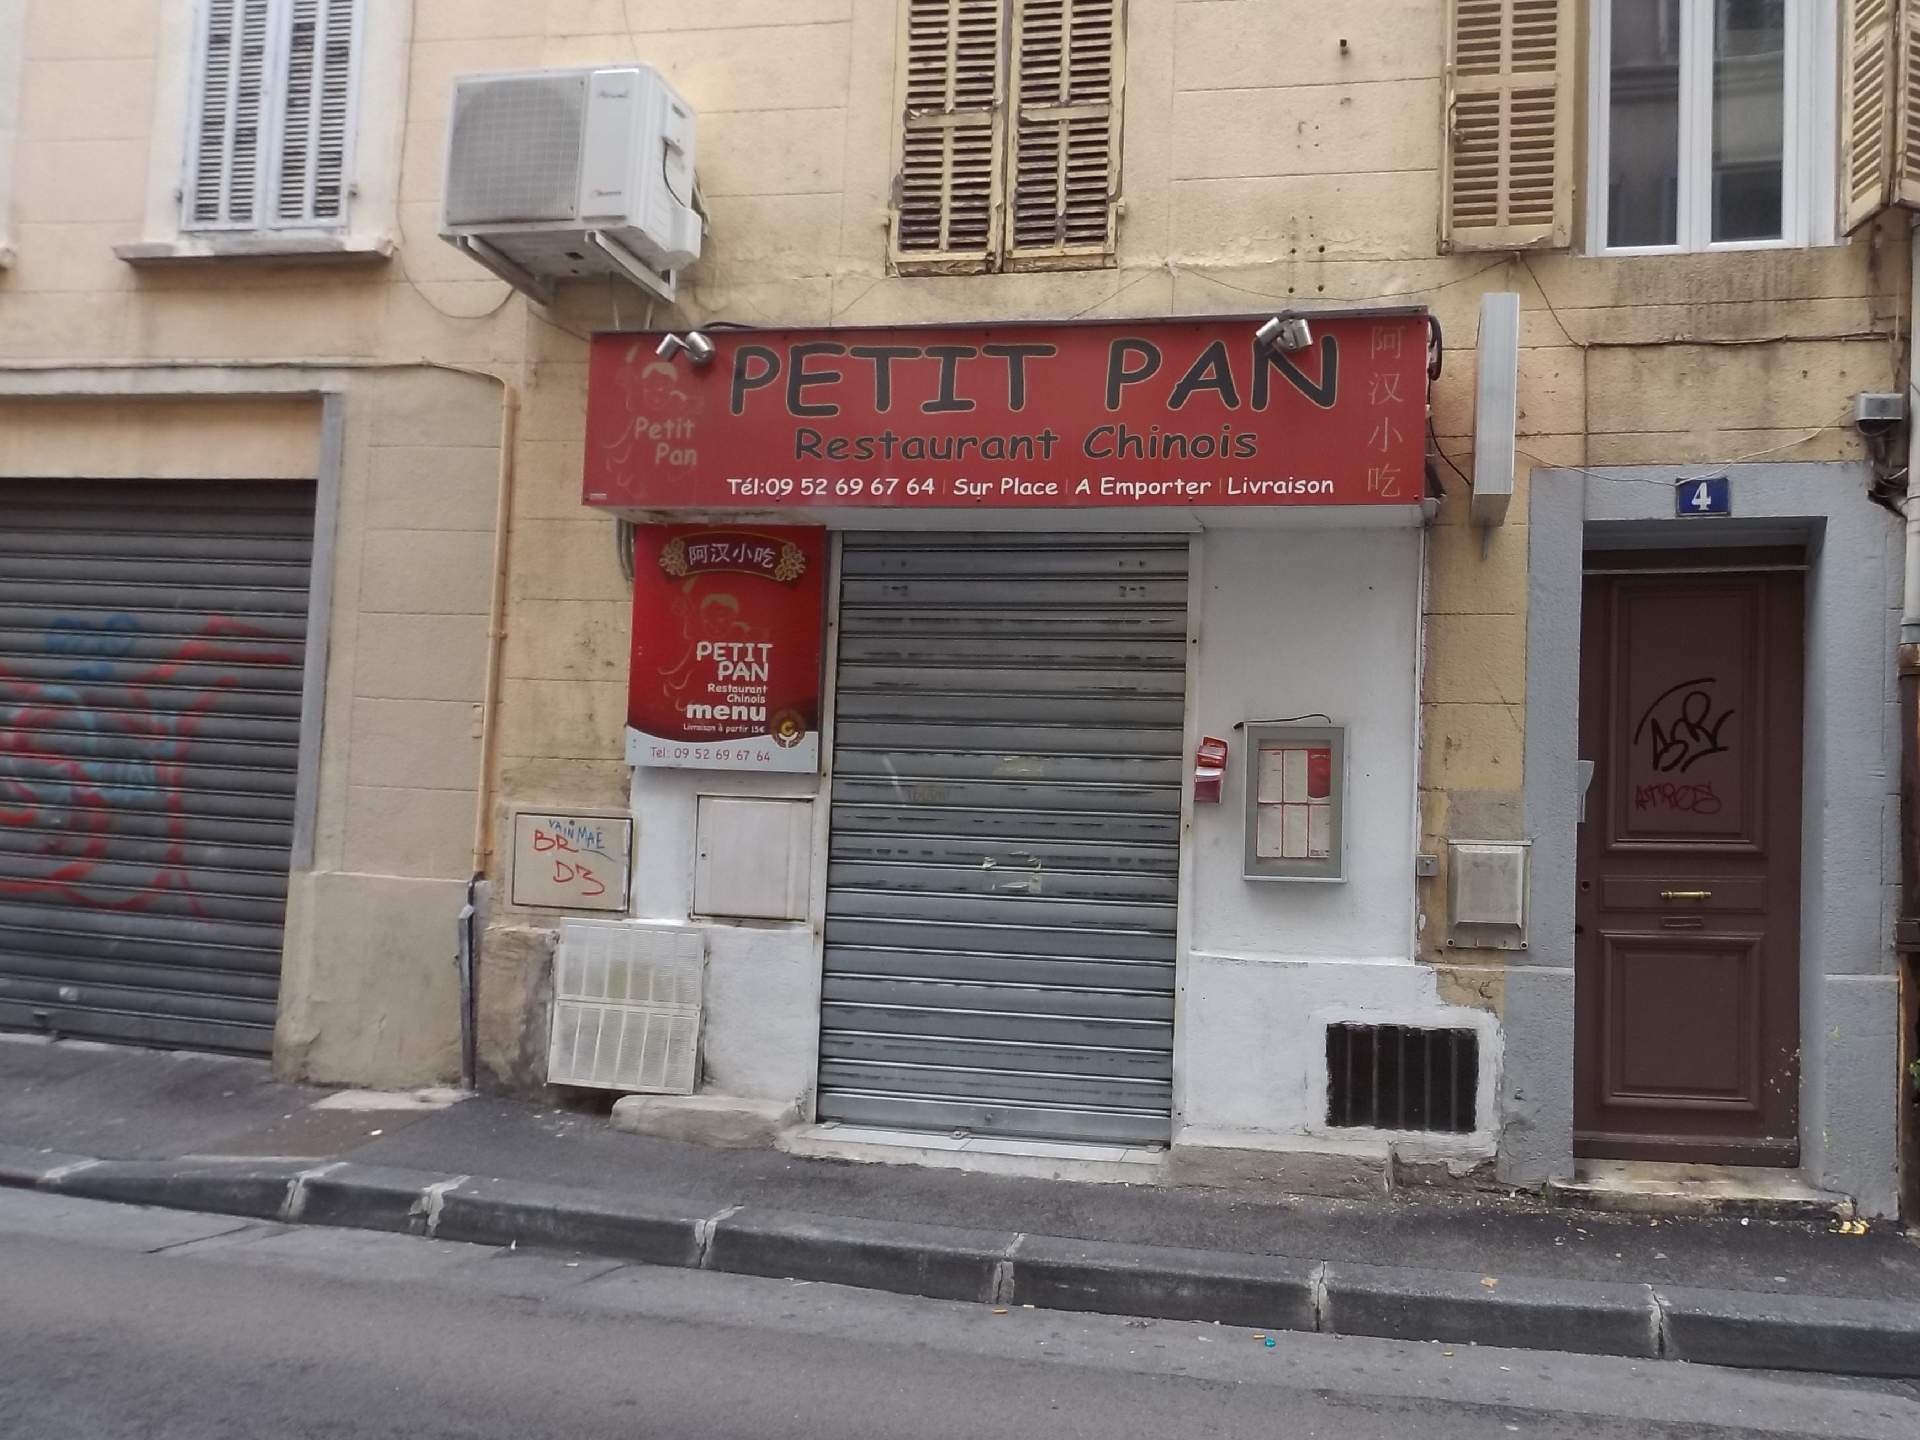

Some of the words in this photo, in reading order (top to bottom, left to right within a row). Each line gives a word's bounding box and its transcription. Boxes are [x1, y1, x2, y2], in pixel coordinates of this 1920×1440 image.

[729, 341, 1058, 417] PETIT
[1104, 335, 1340, 412] PAN
[1367, 326, 1406, 499] 阿汉小吃
[634, 416, 694, 440] Petit
[794, 428, 1060, 461] Restaurant
[1083, 423, 1258, 460] Chinois
[654, 444, 697, 466] Pan
[800, 478, 828, 496] 52
[835, 478, 864, 496] 69
[870, 478, 900, 496] 67
[906, 478, 935, 496] 64
[953, 478, 993, 496] Sur
[1000, 477, 1058, 496] Place
[1075, 478, 1091, 495] A
[1100, 477, 1211, 500] Emporter
[1228, 477, 1334, 495] Livraison
[1691, 482, 1711, 511] 4
[688, 543, 777, 568] 阿汉小吃
[696, 641, 773, 663] PETIT
[717, 661, 769, 682] PAN
[707, 683, 768, 694] Restaurant
[726, 693, 766, 704] Chinois
[686, 704, 767, 721] menu
[674, 748, 690, 758] 09
[695, 748, 710, 760] 52
[715, 749, 730, 760] 69
[736, 750, 751, 761] 67
[756, 751, 771, 762] 64
